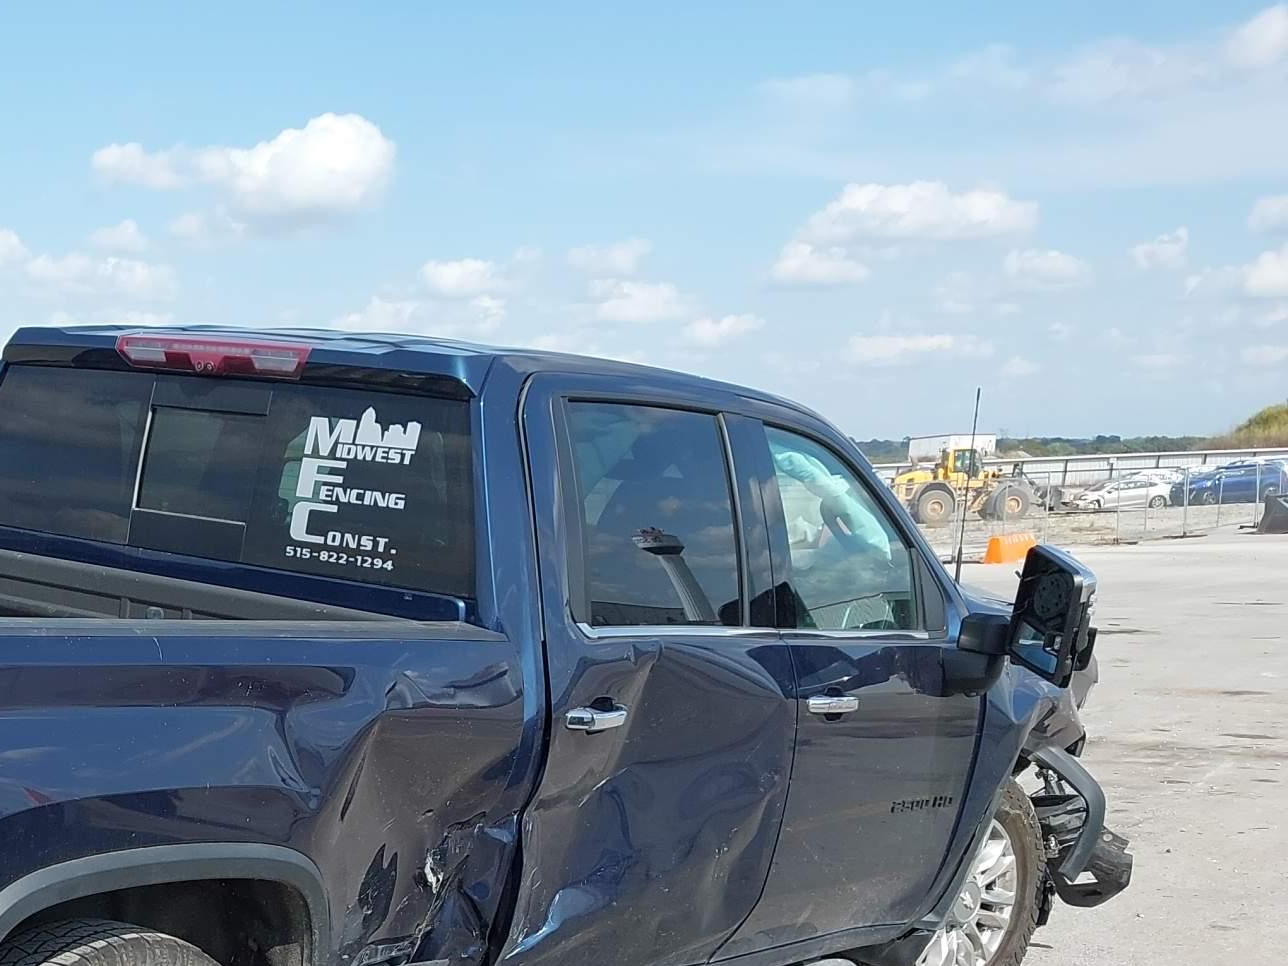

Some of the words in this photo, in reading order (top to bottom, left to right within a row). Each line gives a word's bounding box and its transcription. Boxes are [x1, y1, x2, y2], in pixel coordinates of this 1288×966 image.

[303, 416, 416, 465] MIDWEST
[295, 457, 406, 510] FENCING
[289, 501, 397, 555] CONST.
[285, 546, 394, 571] 515-822-1294
